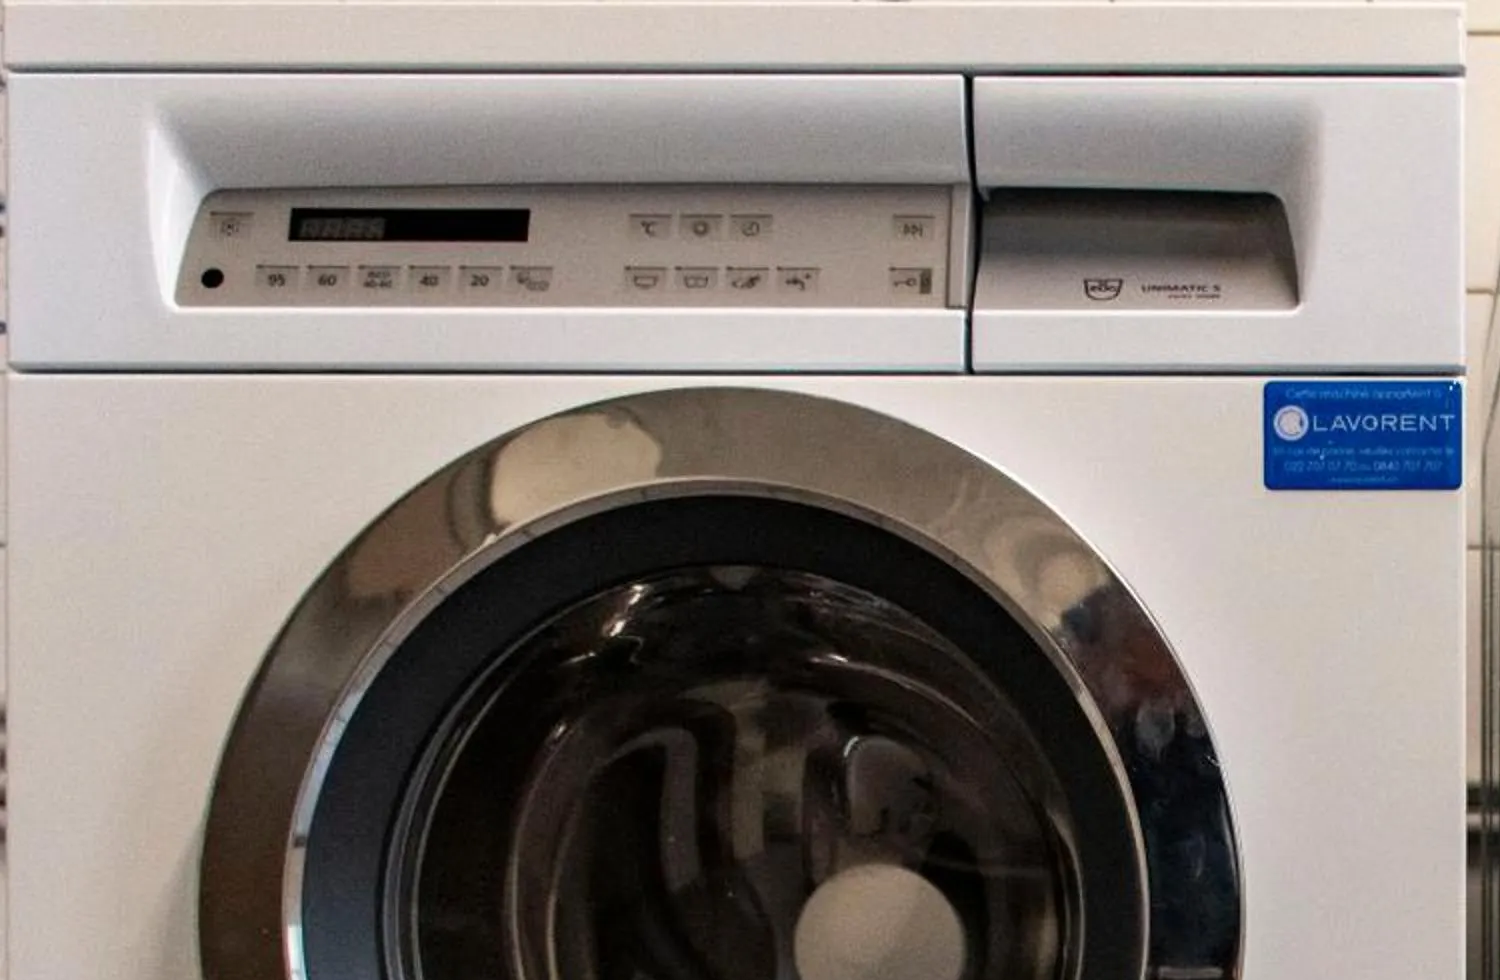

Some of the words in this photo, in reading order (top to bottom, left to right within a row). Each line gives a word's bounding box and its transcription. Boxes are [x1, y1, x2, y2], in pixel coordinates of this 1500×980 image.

[317, 273, 338, 287] 60
[419, 274, 439, 287] 40
[470, 274, 490, 287] 20
[1141, 284, 1209, 293] UNIMATIC
[1312, 414, 1456, 432] LAVORENT
